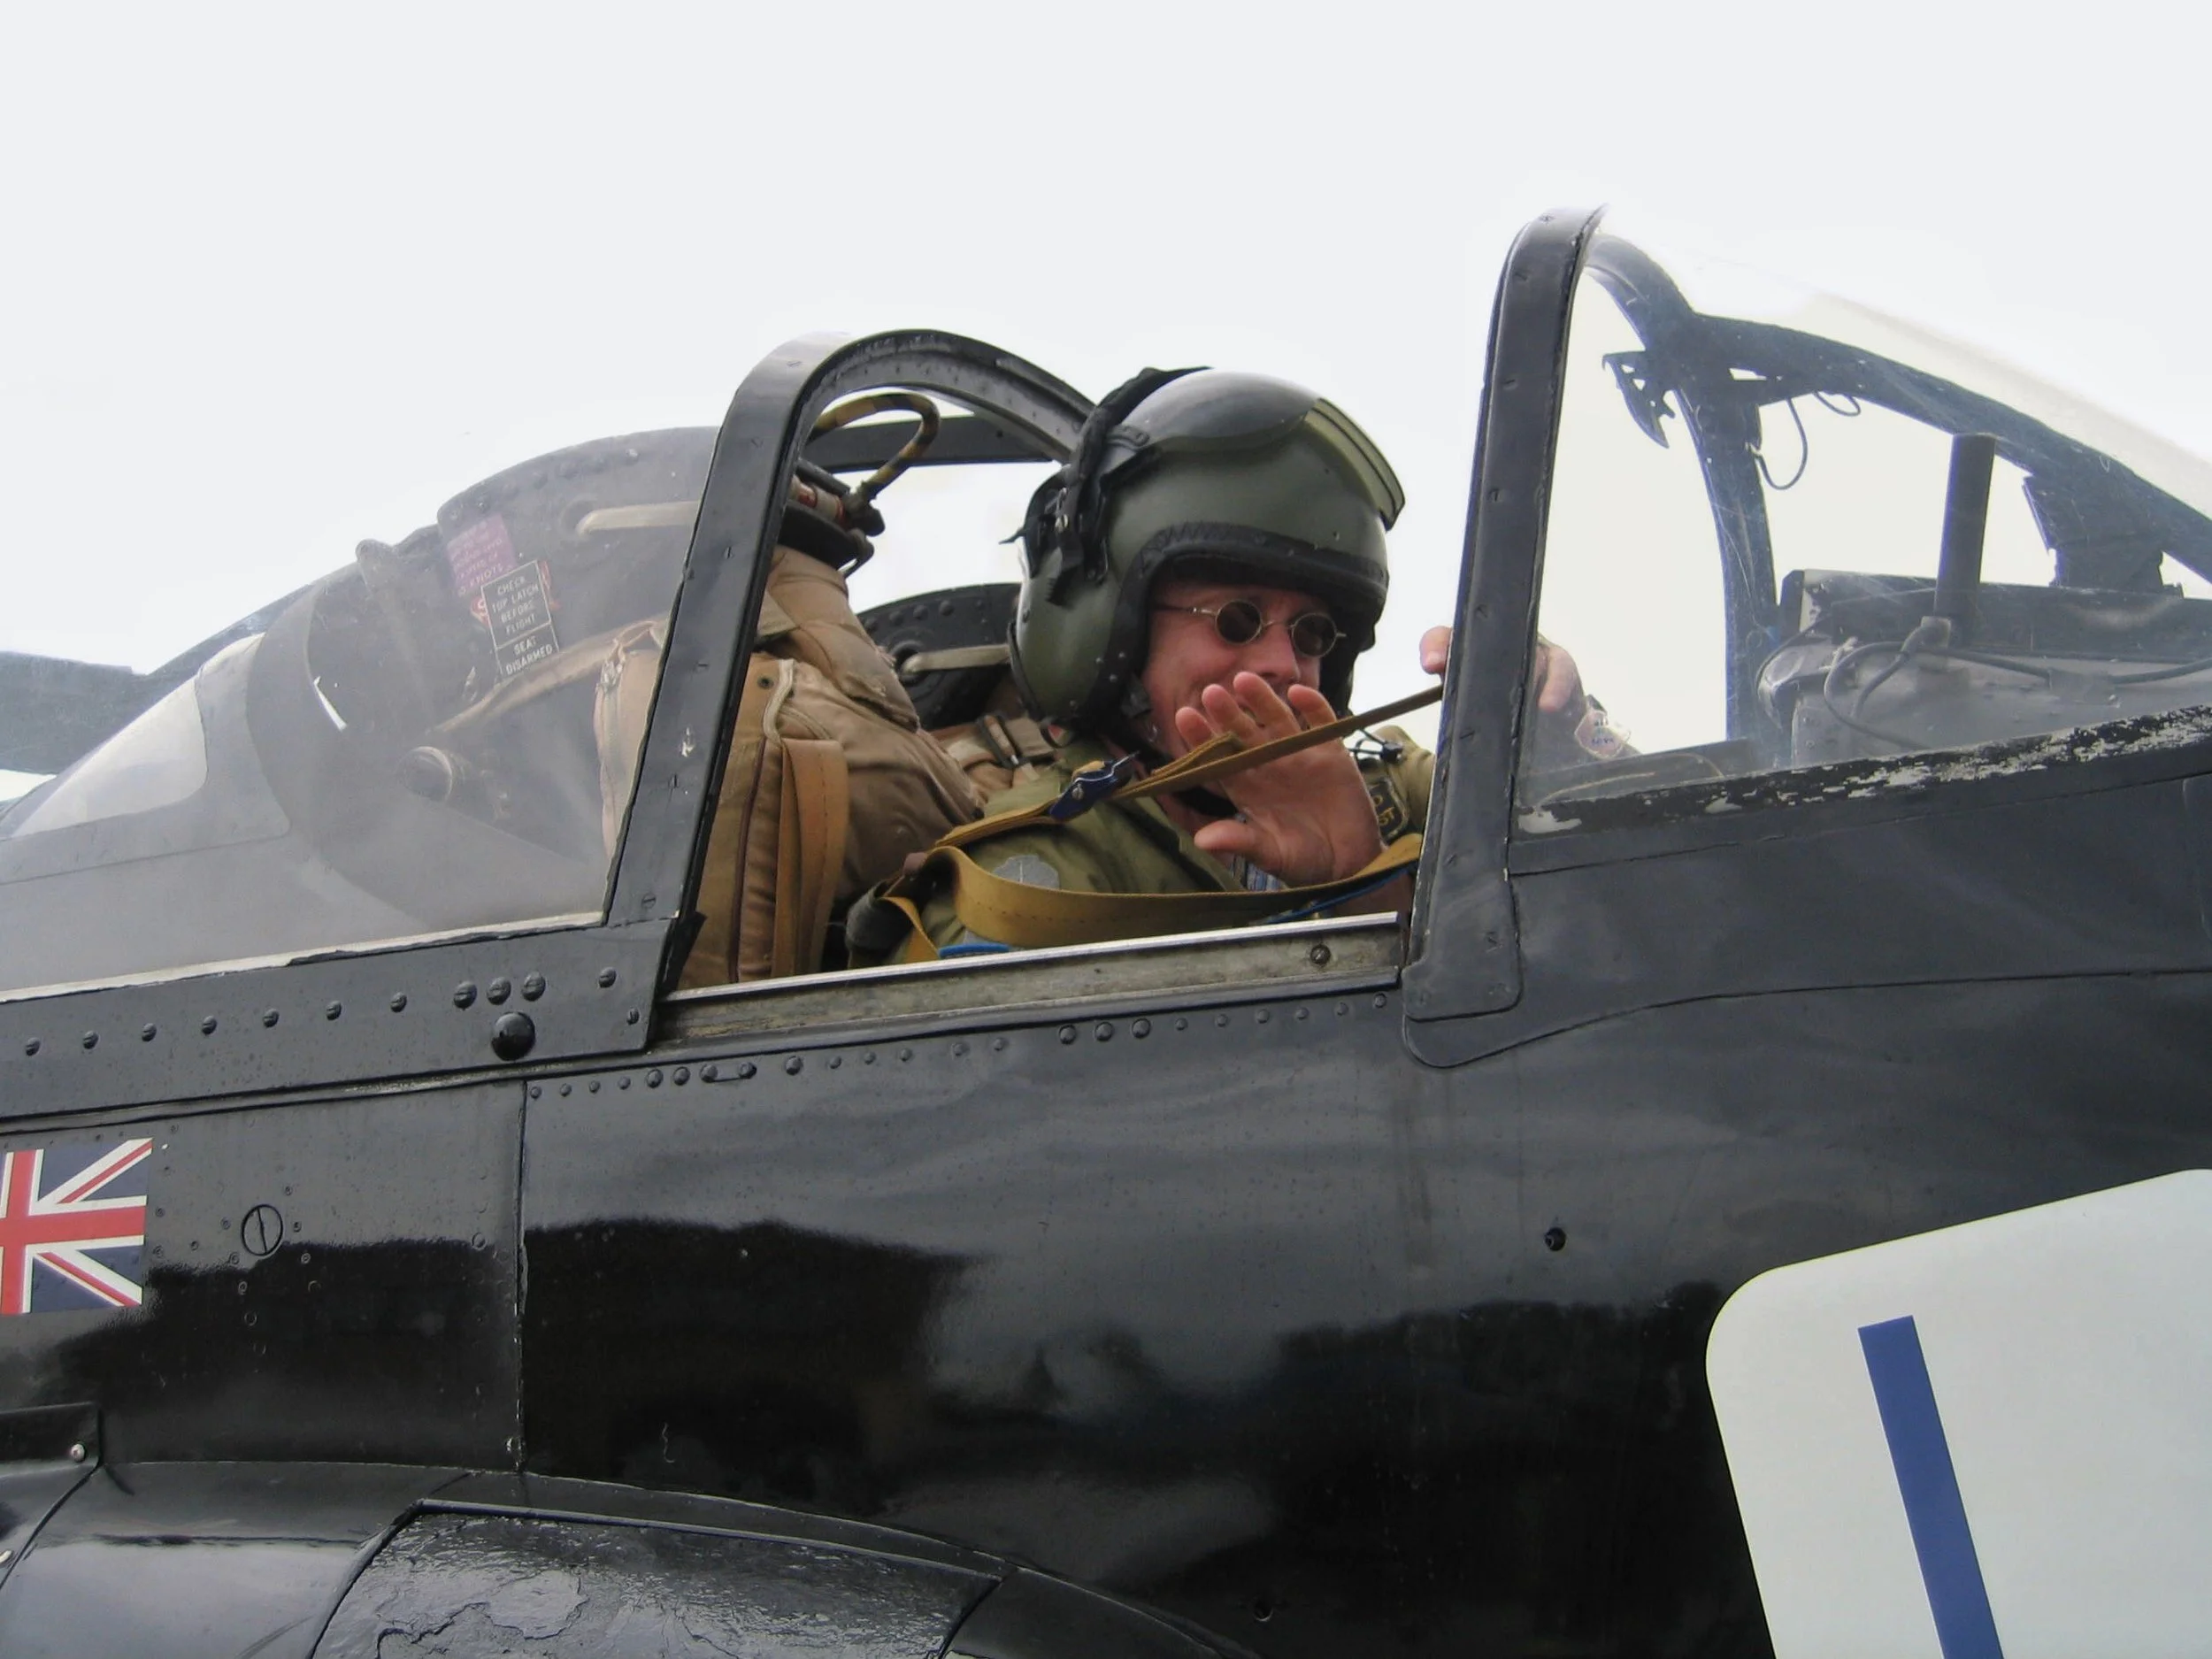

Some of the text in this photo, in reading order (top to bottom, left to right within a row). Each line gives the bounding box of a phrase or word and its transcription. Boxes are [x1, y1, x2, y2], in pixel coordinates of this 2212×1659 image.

[497, 576, 526, 595] CHECK
[492, 597, 508, 613] TOP
[511, 583, 540, 603] LATCH
[501, 597, 534, 623] BEFORE
[505, 612, 535, 635] FLIGHT
[513, 635, 537, 656] SEAT
[505, 643, 553, 675] DISARMED
